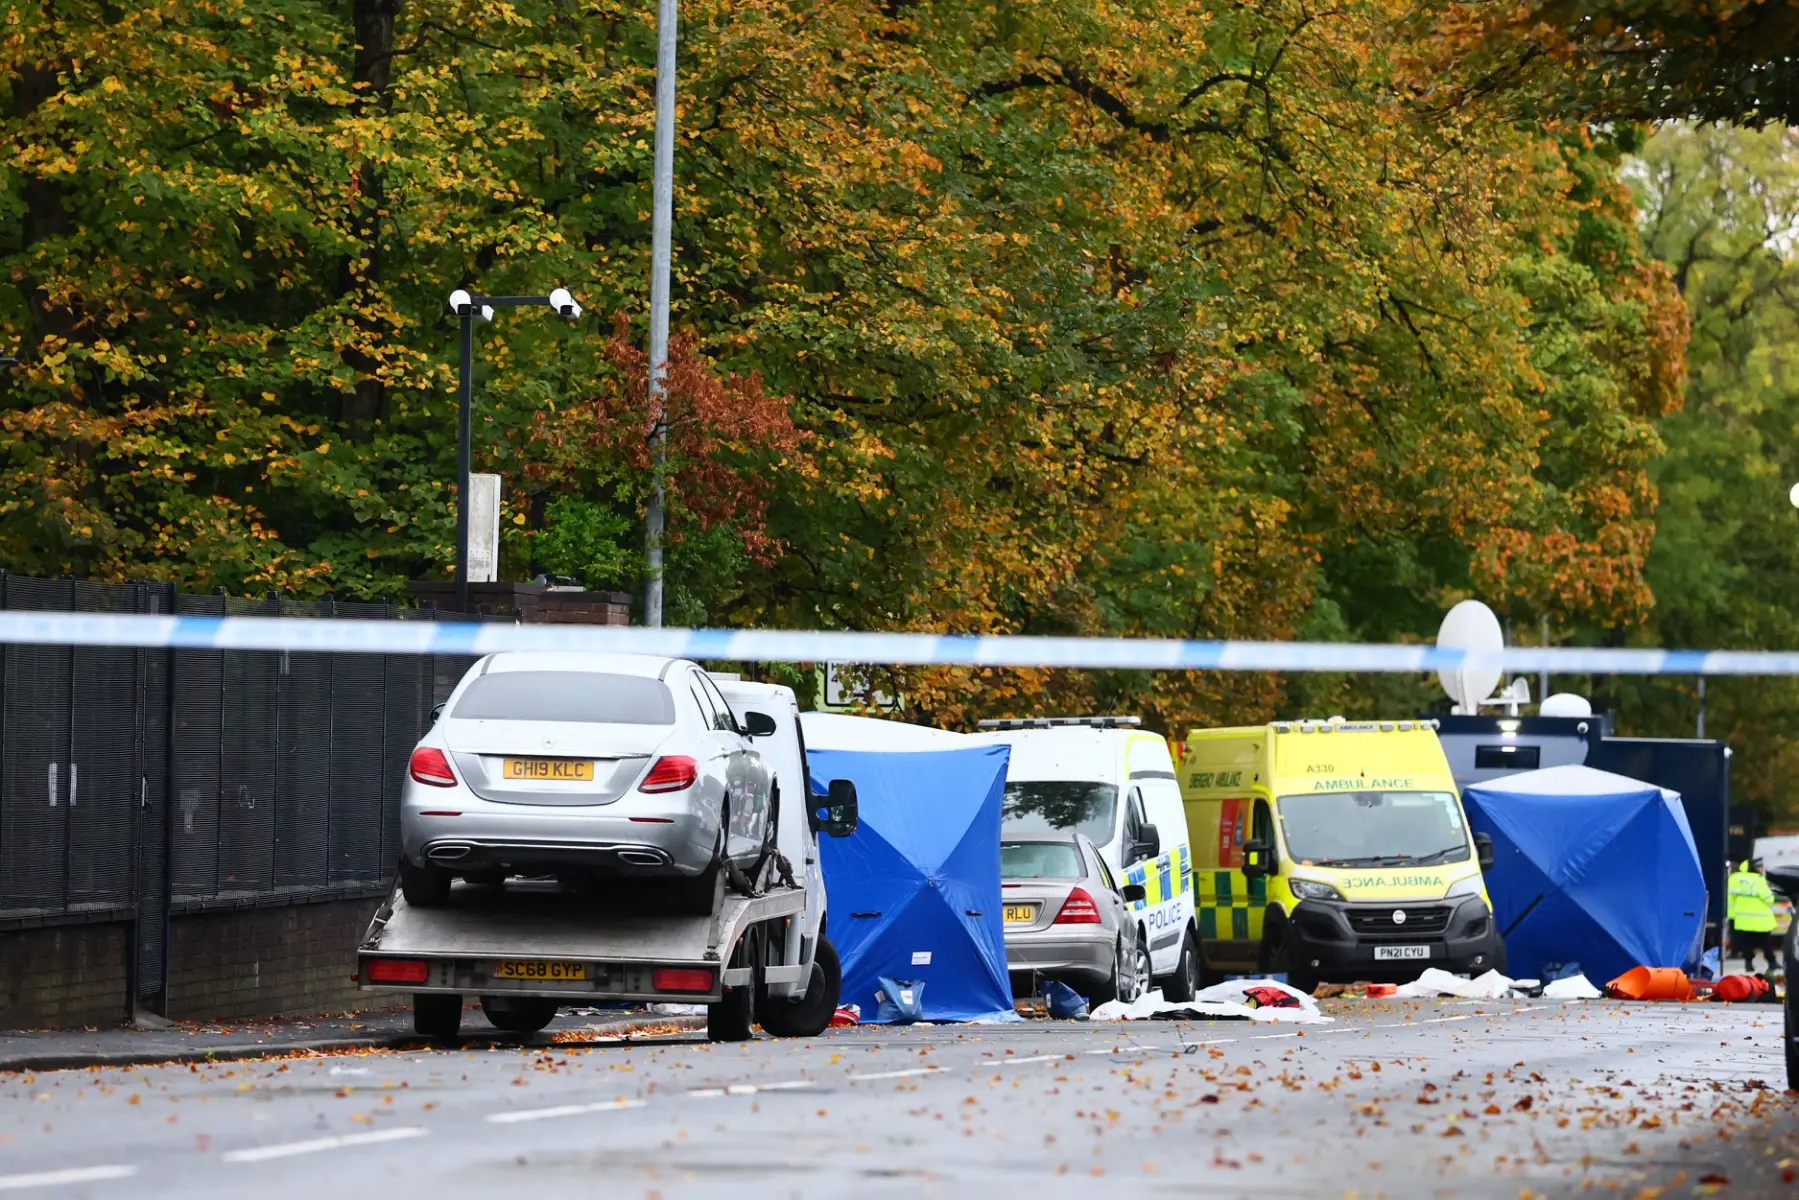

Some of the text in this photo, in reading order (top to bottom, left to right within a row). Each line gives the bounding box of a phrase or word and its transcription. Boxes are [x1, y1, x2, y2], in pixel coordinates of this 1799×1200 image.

[513, 761, 584, 777] GH19 KLC
[1306, 764, 1335, 773] A330
[1313, 779, 1414, 790] AMBULANCE
[1006, 908, 1031, 920] RLU
[1149, 902, 1181, 932] POLICE
[1380, 947, 1424, 958] PN21 CYU
[504, 962, 582, 977] SC68 GYP
